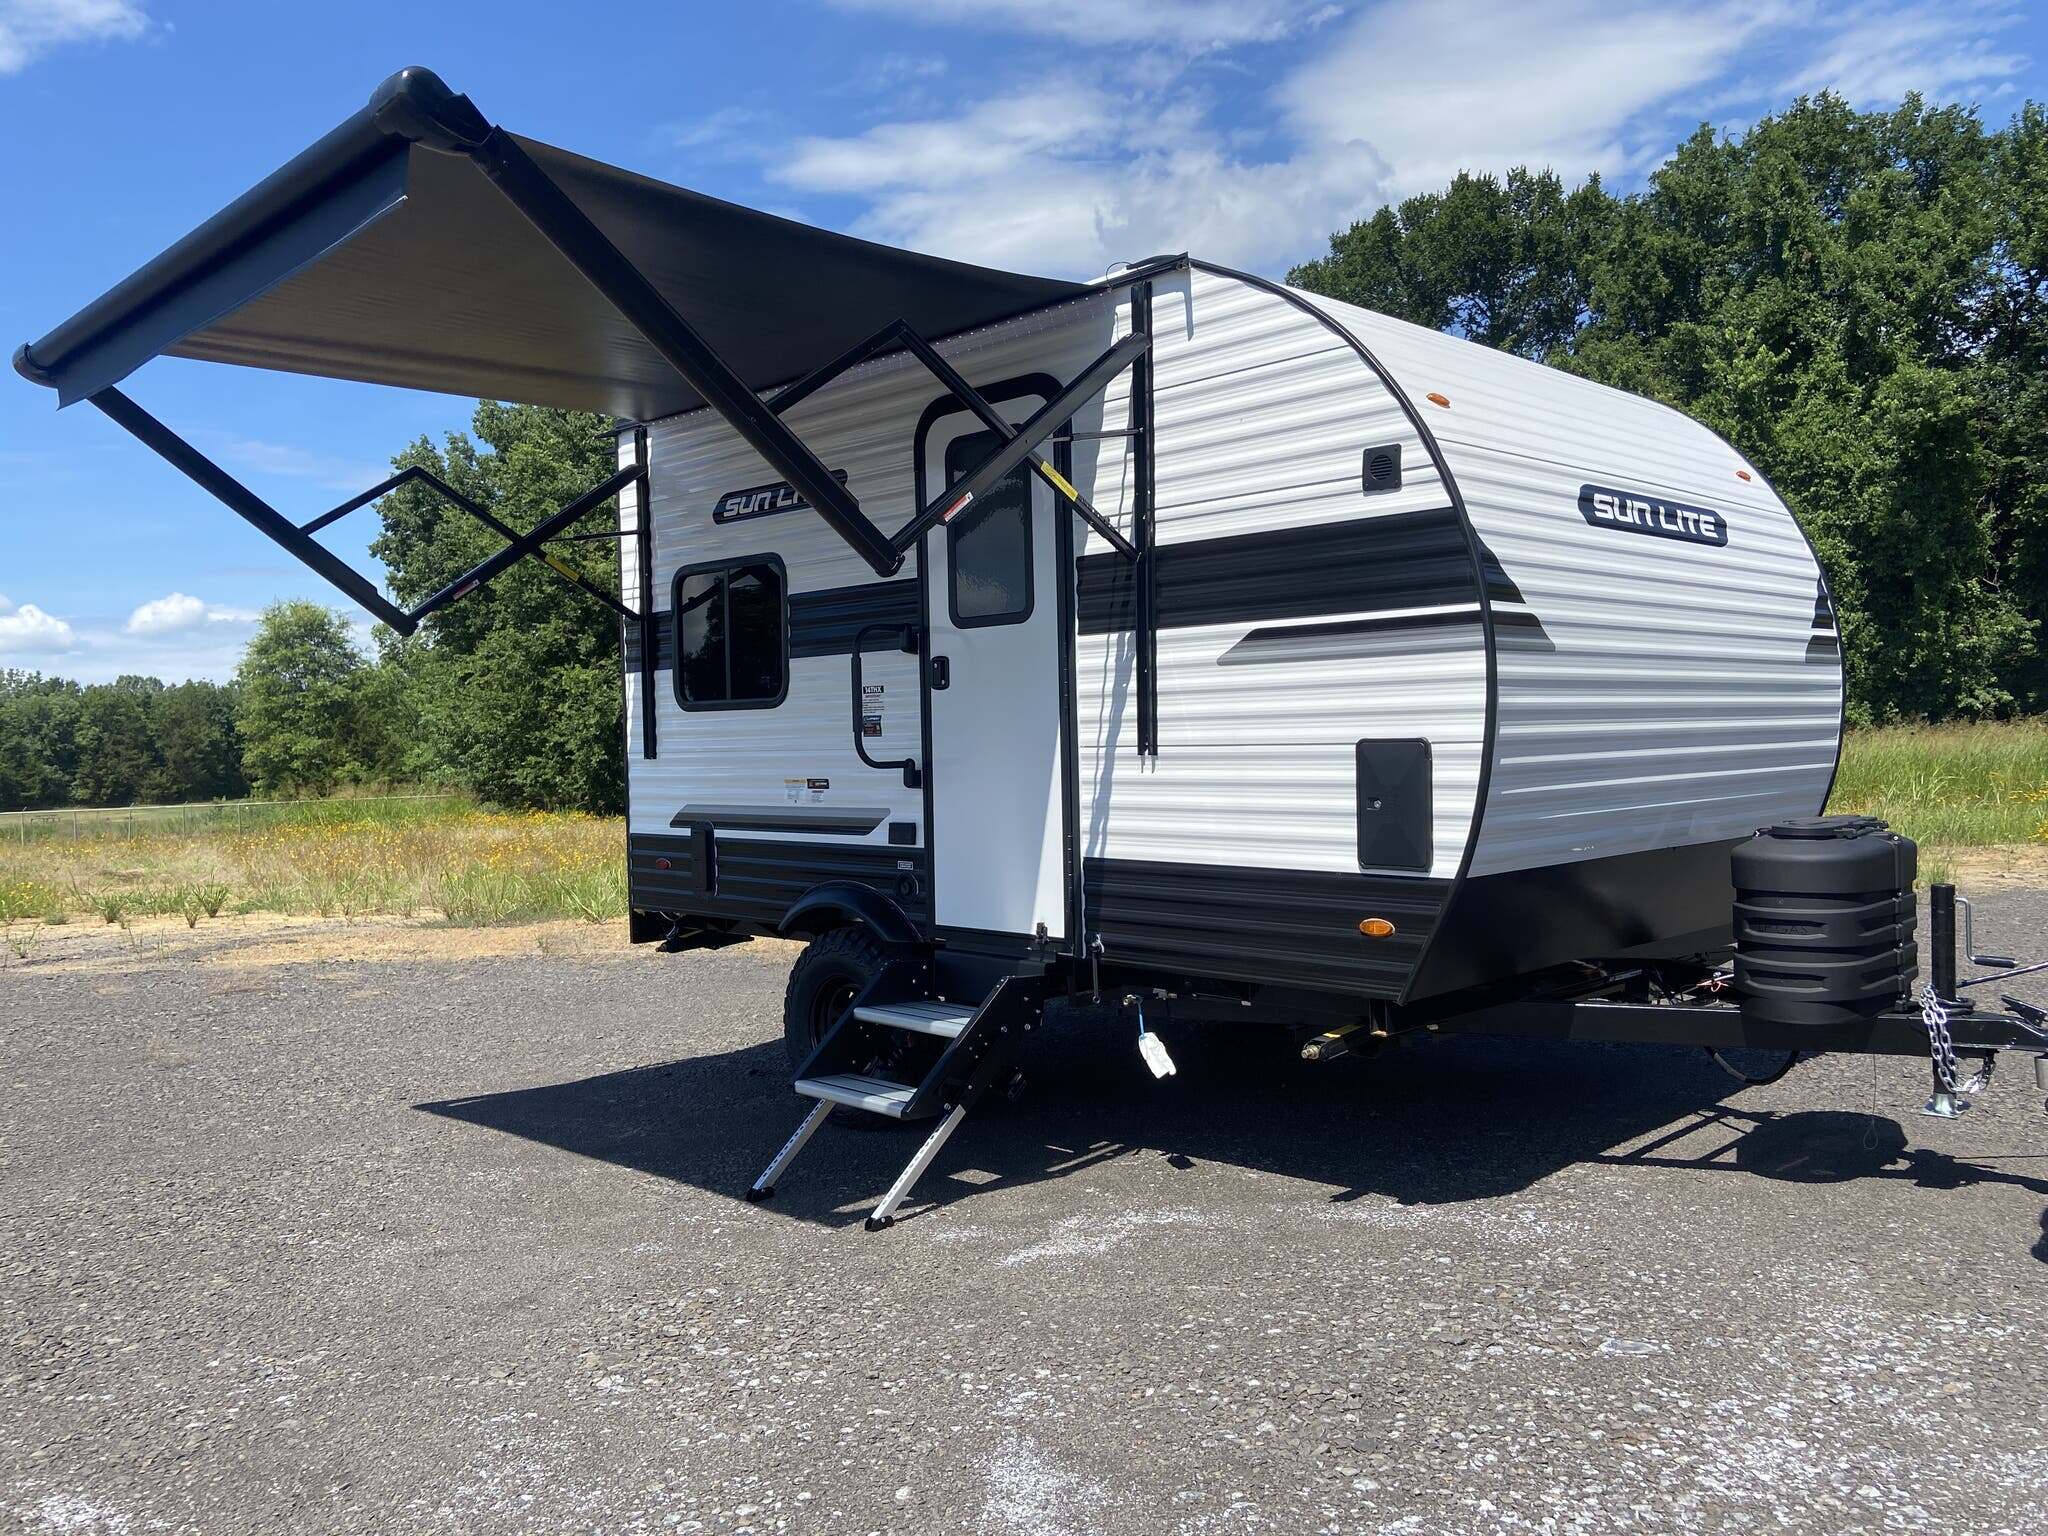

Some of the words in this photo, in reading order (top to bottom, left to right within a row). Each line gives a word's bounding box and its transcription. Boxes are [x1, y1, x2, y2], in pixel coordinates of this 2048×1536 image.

[723, 492, 771, 517] SUN
[776, 488, 807, 507] LI
[1593, 493, 1654, 527] SUN
[1658, 505, 1719, 538] LITE
